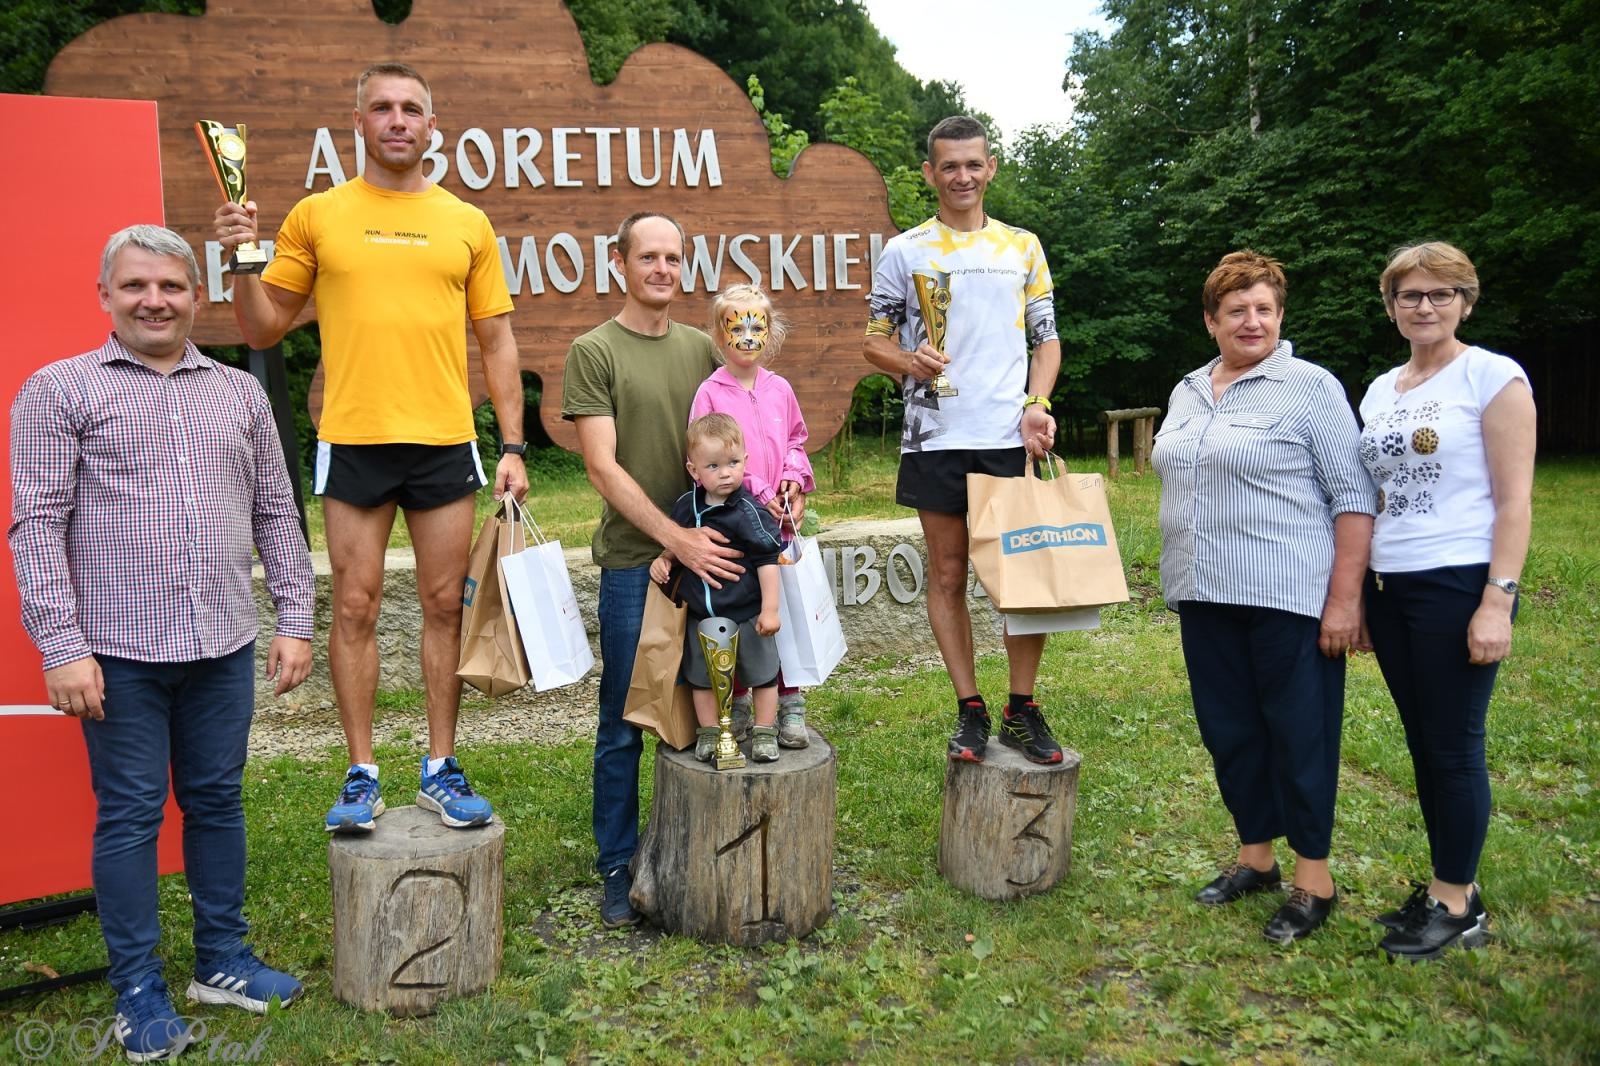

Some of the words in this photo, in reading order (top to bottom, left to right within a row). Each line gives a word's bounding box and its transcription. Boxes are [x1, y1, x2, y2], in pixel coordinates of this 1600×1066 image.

[305, 127, 723, 190] ABORETUM
[394, 231, 428, 239] WARSAW
[1009, 527, 1098, 549] DECATHLON
[715, 812, 772, 923] 1
[1005, 791, 1054, 887] 3
[388, 868, 468, 990] 2
